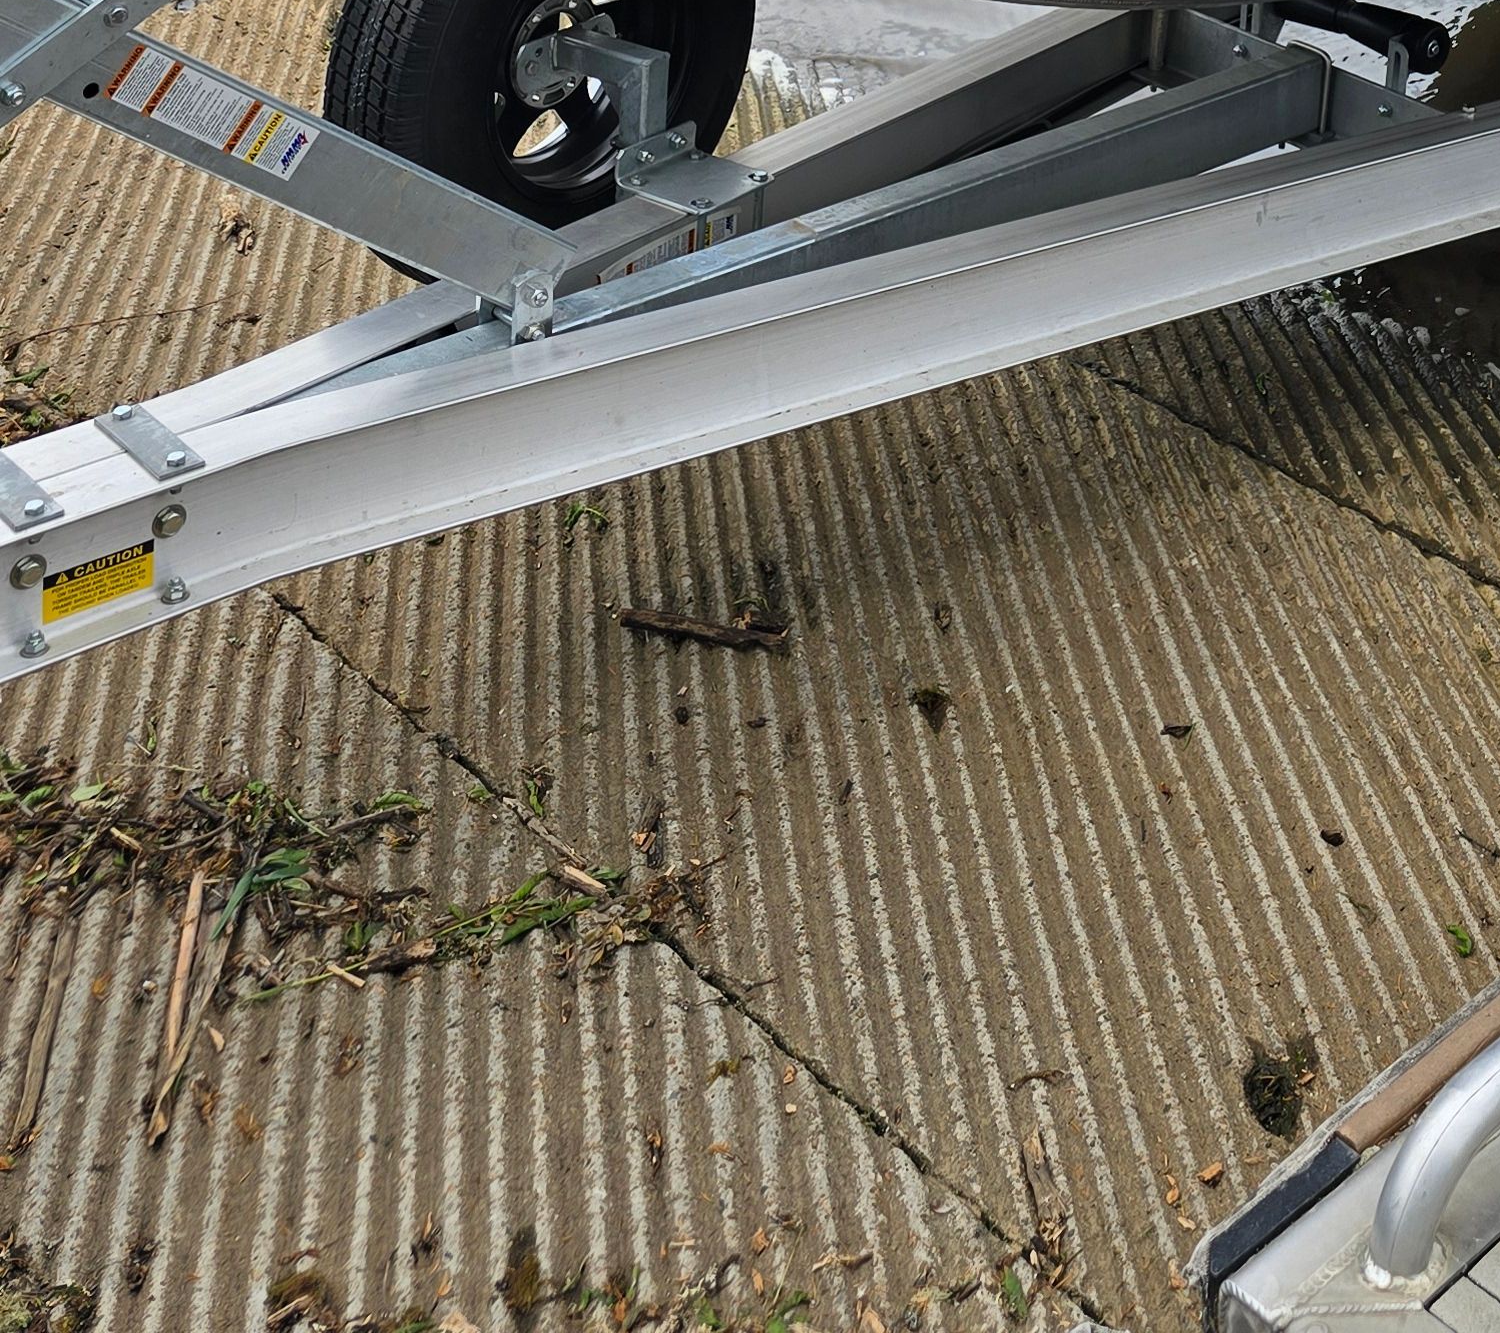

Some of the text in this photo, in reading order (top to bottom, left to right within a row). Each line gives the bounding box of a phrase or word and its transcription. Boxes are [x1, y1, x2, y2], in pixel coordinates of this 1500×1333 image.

[112, 46, 143, 88] WARNING
[151, 65, 180, 106] WARNING
[253, 113, 282, 153] CAUTION
[74, 545, 143, 578] CAUTION
